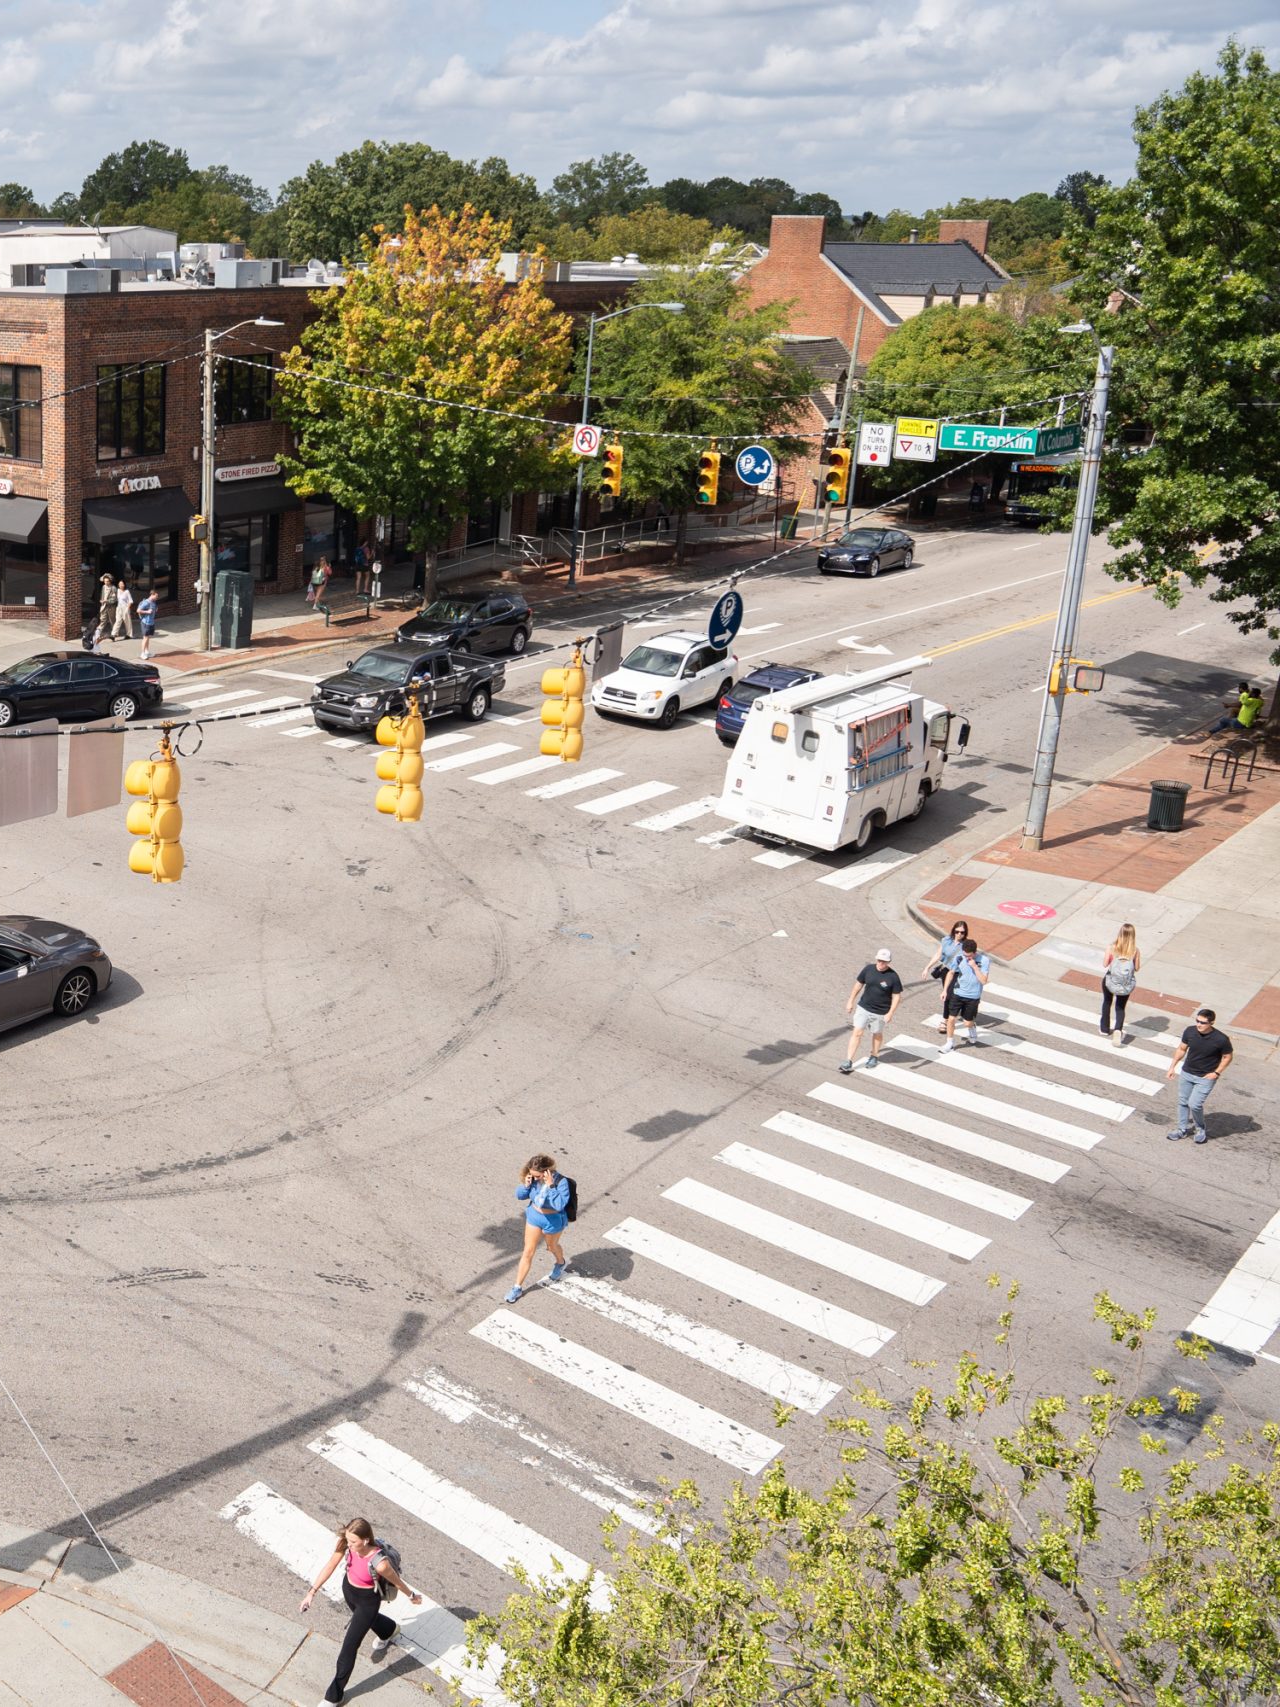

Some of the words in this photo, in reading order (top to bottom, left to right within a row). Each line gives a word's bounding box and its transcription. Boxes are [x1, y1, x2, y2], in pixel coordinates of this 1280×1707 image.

[870, 427, 884, 435] NO
[953, 429, 969, 446] E.
[972, 430, 1033, 449] Franklin
[220, 470, 241, 480] STONE
[241, 466, 260, 477] FIRED
[260, 463, 278, 474] PIZZA
[129, 475, 162, 492] LOTSA
[724, 598, 733, 616] P
